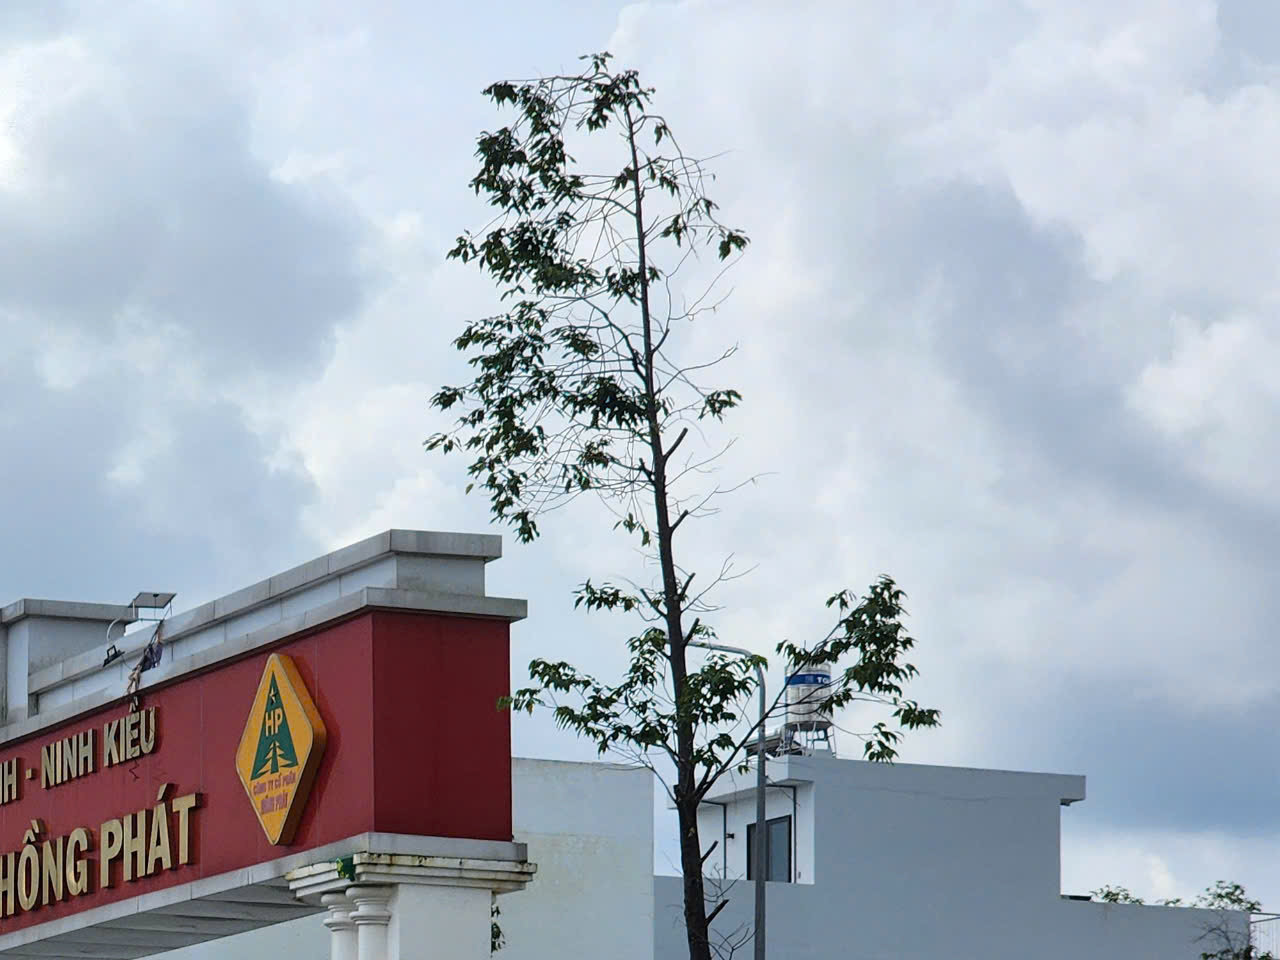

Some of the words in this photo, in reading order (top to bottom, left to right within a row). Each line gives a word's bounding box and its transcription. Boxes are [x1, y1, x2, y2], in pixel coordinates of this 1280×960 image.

[41, 728, 94, 789] NINH
[103, 696, 157, 768] KIỀU
[265, 708, 283, 736] HP
[100, 783, 197, 889] PHÁT
